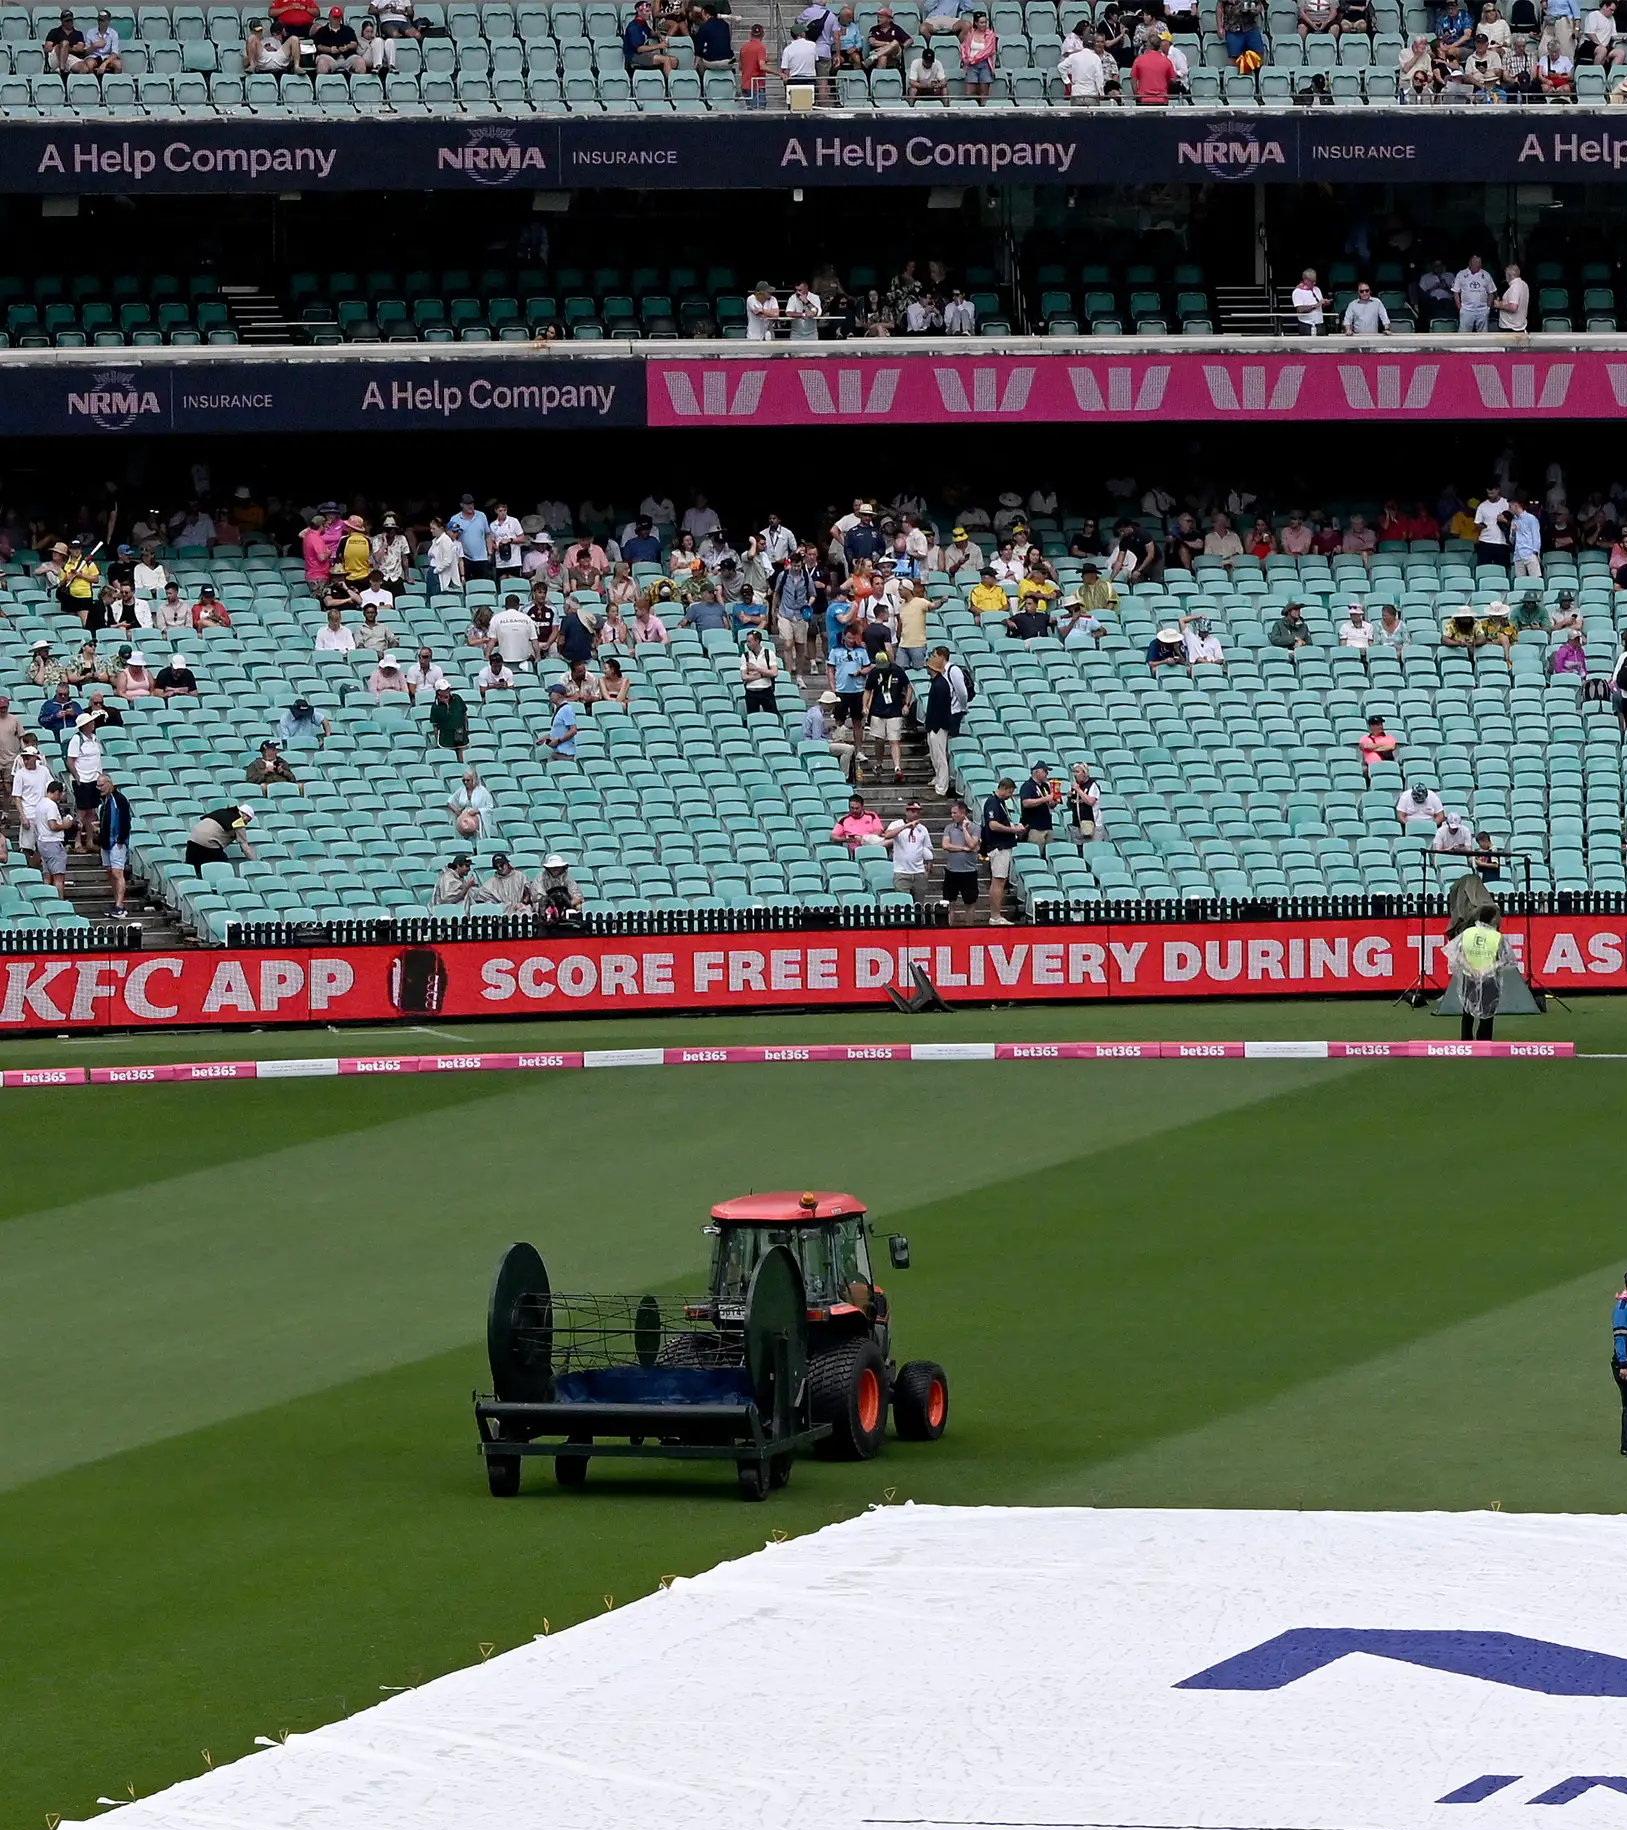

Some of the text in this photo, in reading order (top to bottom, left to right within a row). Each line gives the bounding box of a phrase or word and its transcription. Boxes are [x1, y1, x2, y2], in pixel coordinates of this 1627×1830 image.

[1178, 142, 1415, 163] NRMA INSURANCE
[1519, 134, 1544, 161] A
[438, 148, 678, 169] NRMA INSURANCE
[781, 137, 1076, 172] A Help Company
[38, 143, 337, 179] A Help Company
[68, 393, 273, 414] NRMA INSURANCE
[362, 380, 616, 416] A Help Company
[480, 951, 675, 1001] SCORE
[694, 948, 839, 993] FREE
[855, 941, 1149, 989] DELIVERY
[1163, 935, 1393, 982] DURING
[1407, 933, 1525, 975] TE
[0, 957, 355, 1022] KFC APP
[682, 1050, 727, 1062] bet365
[764, 1049, 809, 1060] bet365
[846, 1047, 892, 1059] bet365
[1013, 1045, 1058, 1057] bet365
[1096, 1045, 1141, 1057] bet365
[1180, 1045, 1225, 1057] bet365
[1345, 1044, 1390, 1056] bet365
[1427, 1044, 1472, 1056] bet365
[1510, 1044, 1555, 1056] bet365
[357, 1060, 401, 1071] bet365
[437, 1057, 481, 1068] bet365
[518, 1055, 563, 1067] bet365
[22, 1071, 66, 1083] bet365
[110, 1069, 155, 1081] bet365
[191, 1065, 236, 1077] bet365
